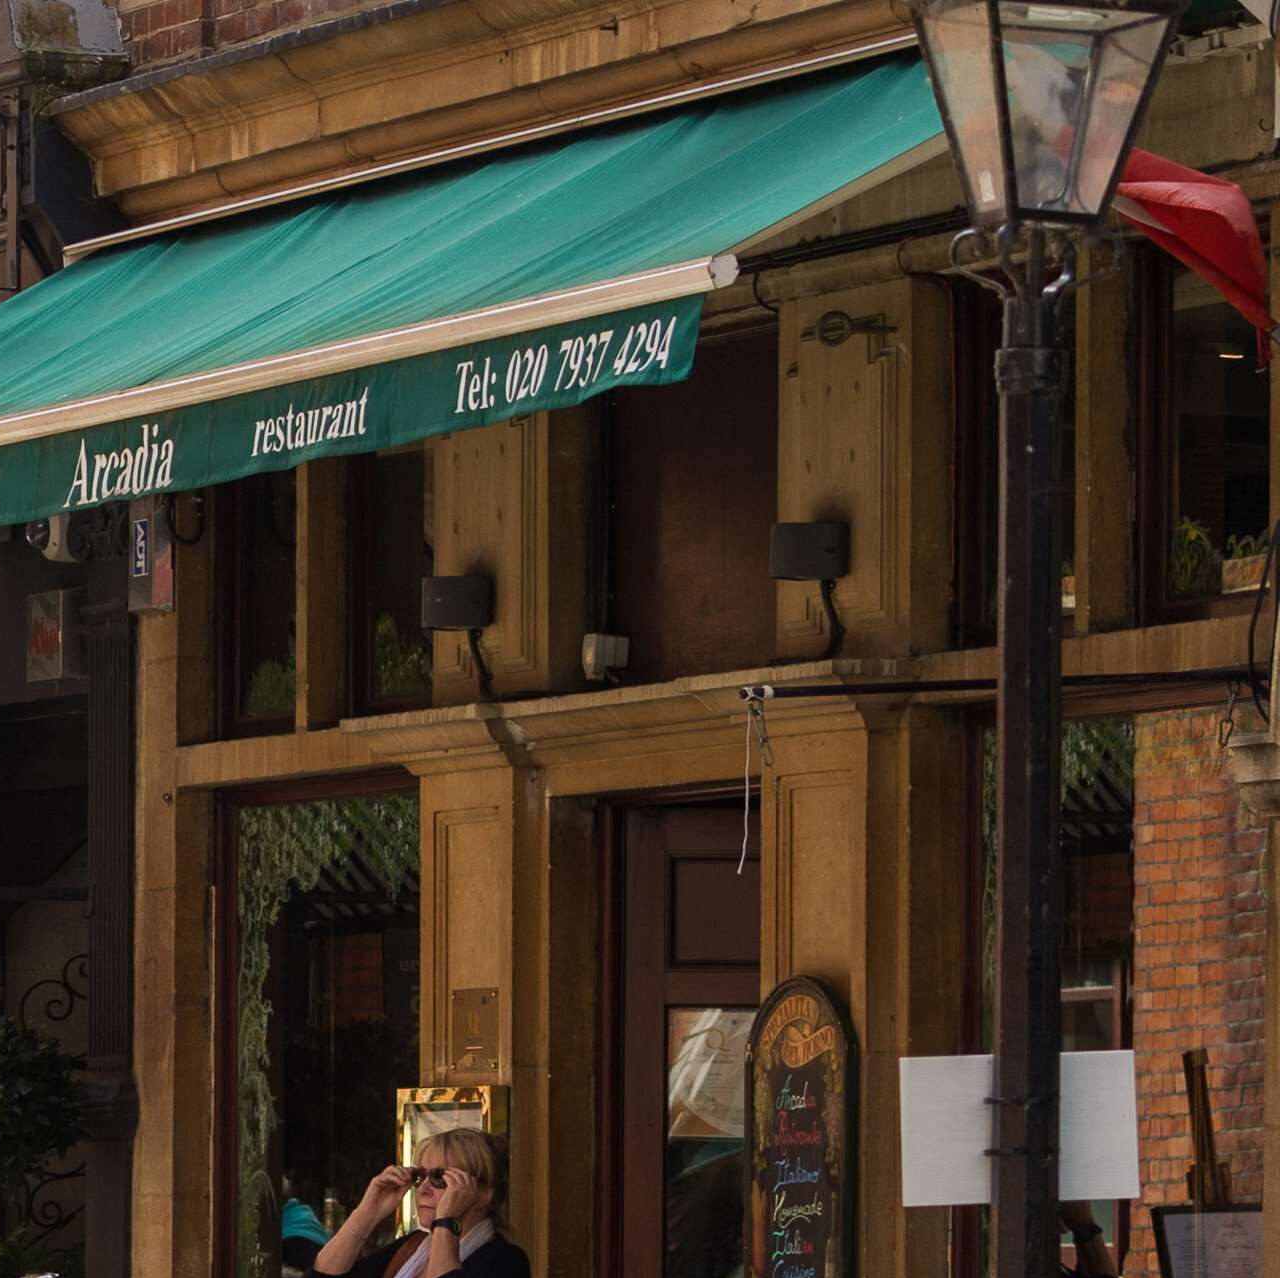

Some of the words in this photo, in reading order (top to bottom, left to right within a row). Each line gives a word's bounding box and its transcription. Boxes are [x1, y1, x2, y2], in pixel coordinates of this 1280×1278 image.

[454, 357, 497, 413] Tel:
[505, 344, 548, 403] 020
[554, 330, 614, 391] 7937
[613, 316, 677, 376] 4294
[251, 386, 369, 457] restaurant
[62, 423, 175, 508] Arcadia
